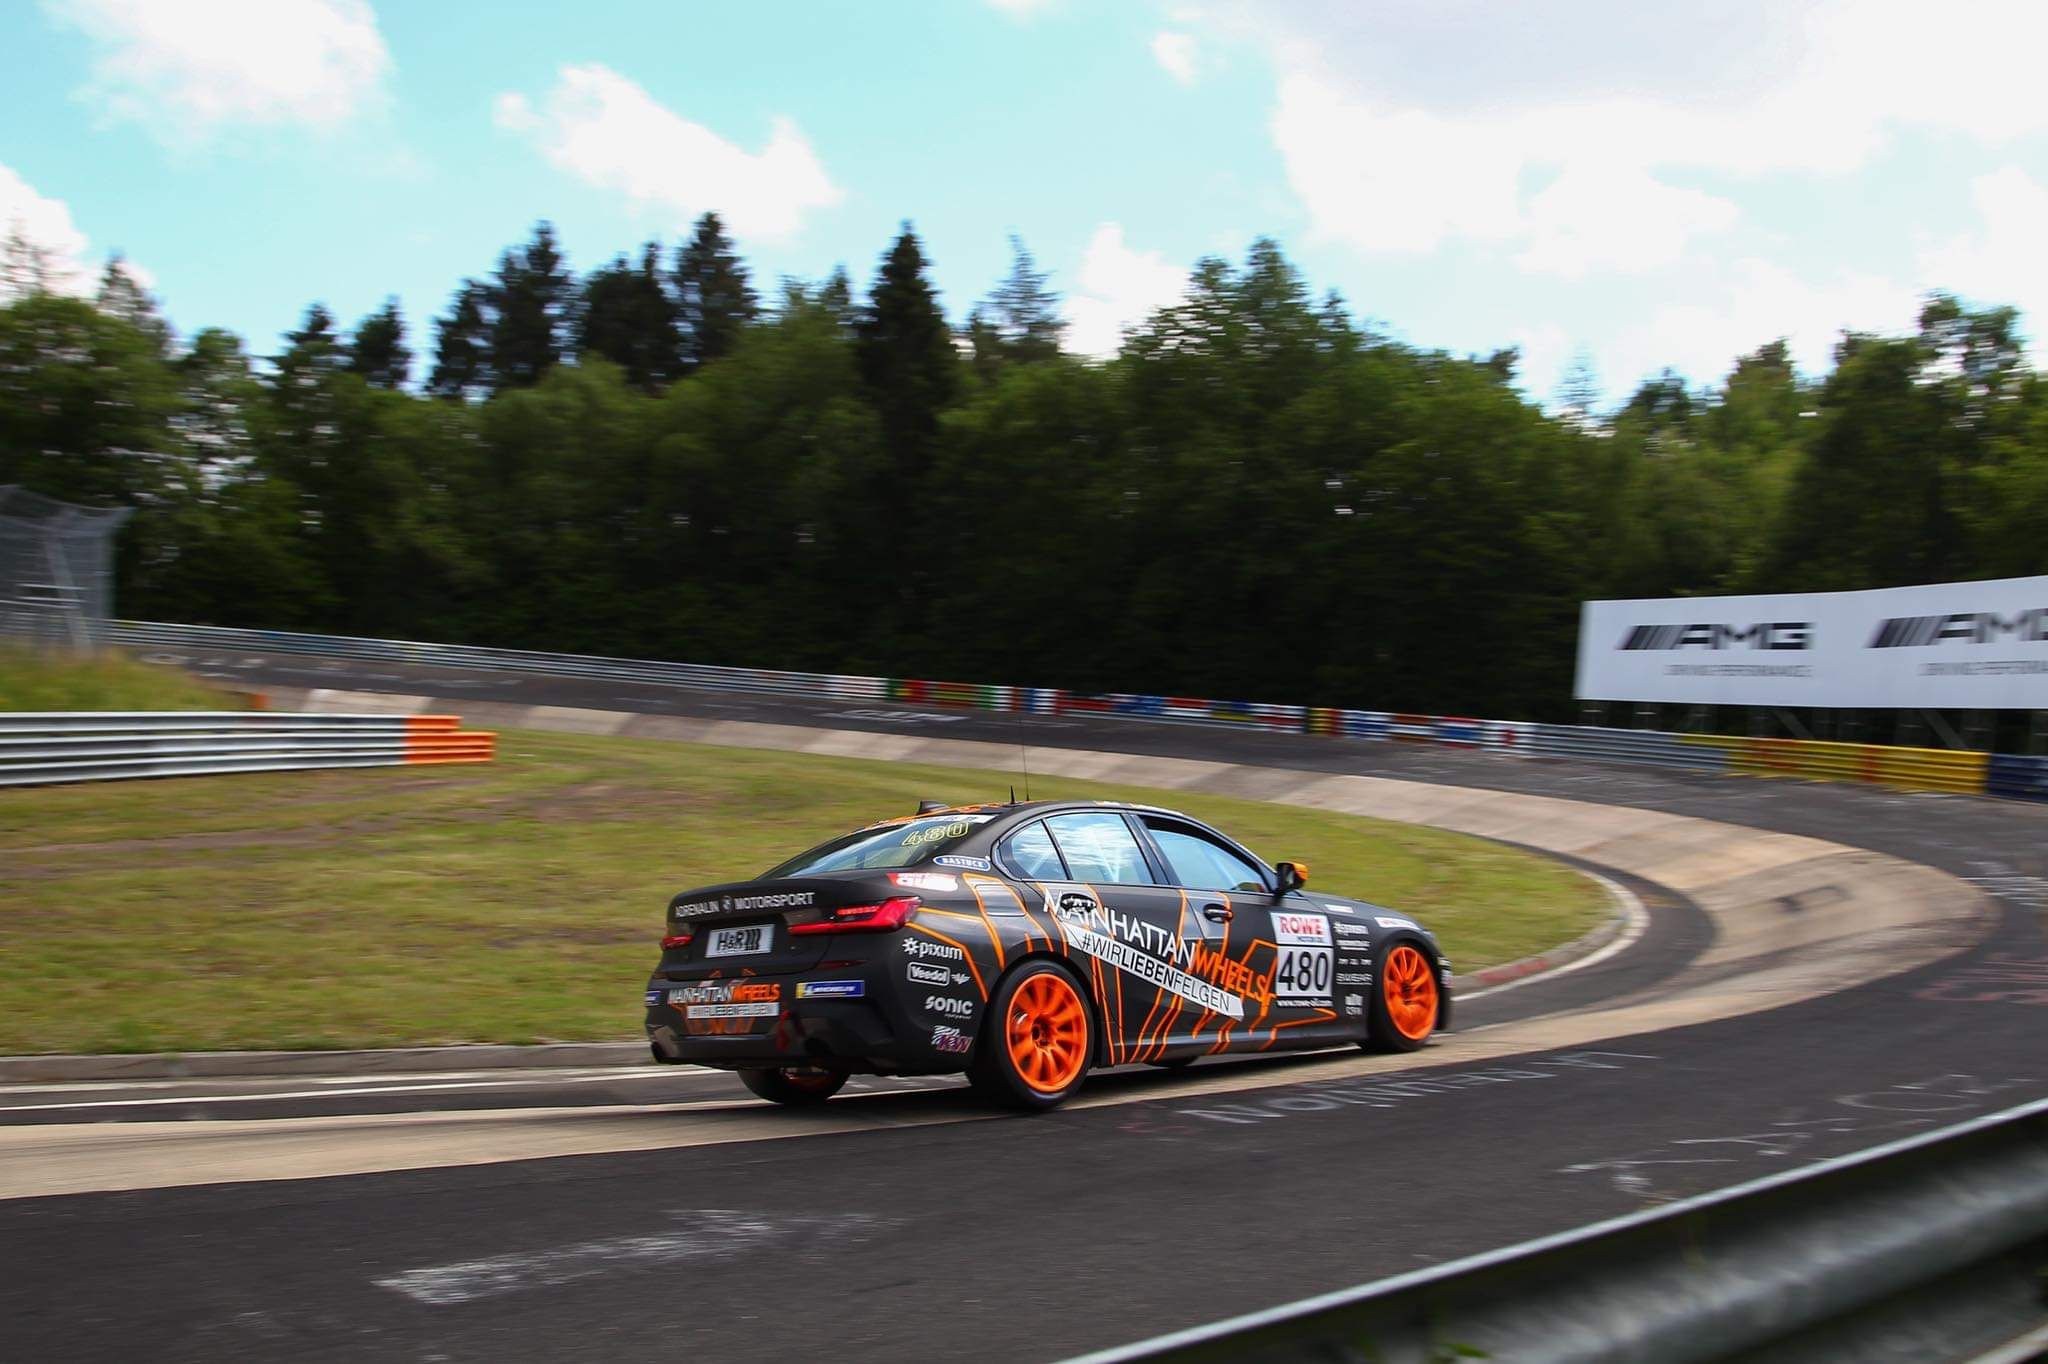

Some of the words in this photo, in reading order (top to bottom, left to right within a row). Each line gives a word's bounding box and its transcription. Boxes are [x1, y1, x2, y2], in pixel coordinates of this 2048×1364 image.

[1669, 621, 1814, 651] AMG
[901, 821, 969, 846] 480
[675, 899, 721, 918] ADRENALIN
[733, 892, 815, 911] MOTORSPORT
[1279, 916, 1323, 935] ROWE
[919, 941, 963, 960] pixum
[911, 965, 948, 982] Veedol
[1081, 931, 1231, 1012] #WIRLIEBENFELGEN
[1277, 950, 1329, 992] 480
